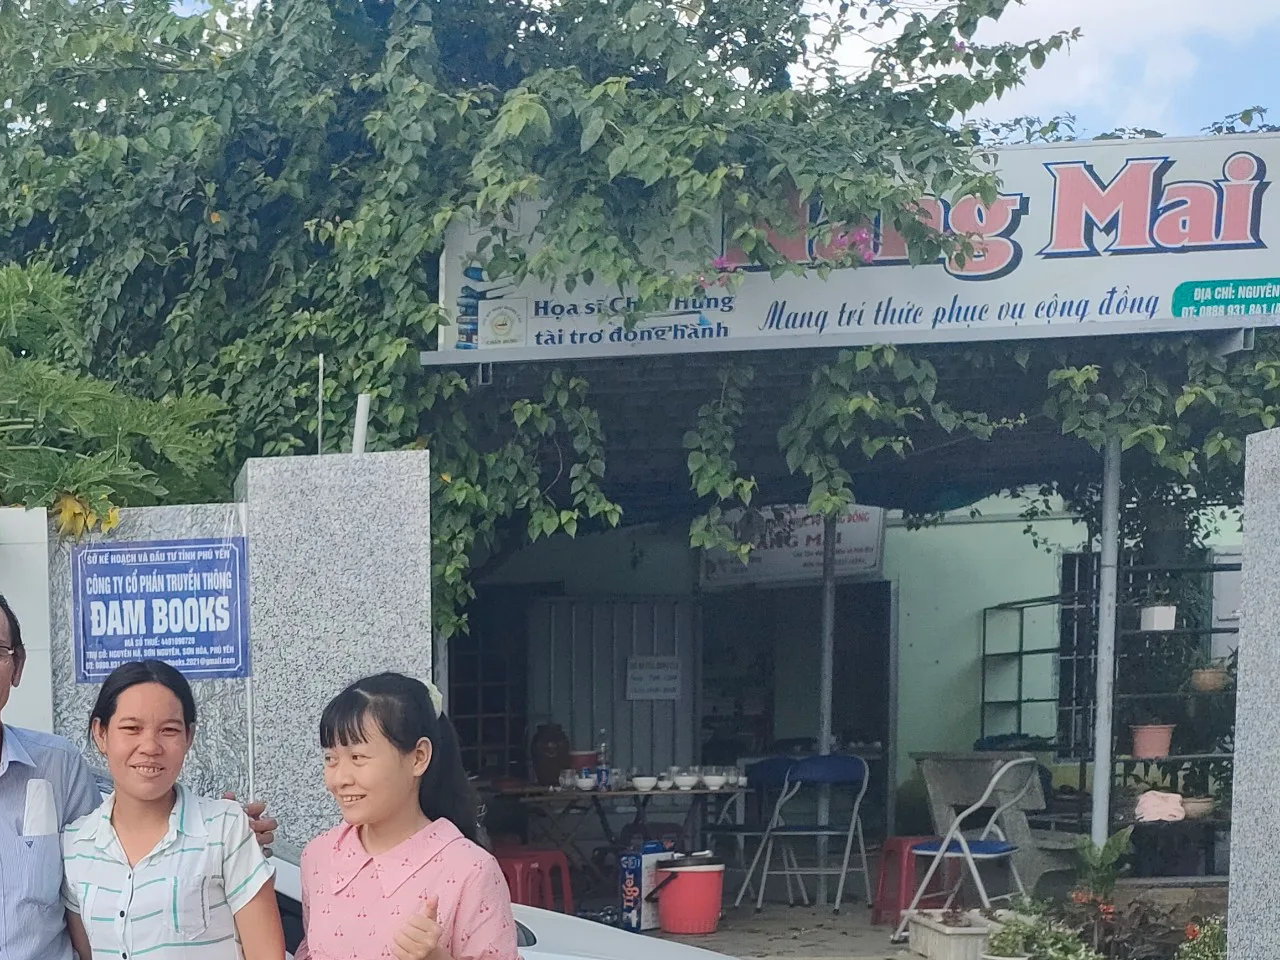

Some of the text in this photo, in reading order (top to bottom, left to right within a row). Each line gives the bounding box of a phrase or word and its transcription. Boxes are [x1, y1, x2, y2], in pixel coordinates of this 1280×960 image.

[1035, 151, 1271, 259] Mai
[1194, 287, 1212, 303] ĐỊA
[1214, 282, 1235, 299] CHỈ:
[534, 300, 579, 320] Họa
[758, 285, 1160, 334] Mang trí thức phục vụ cộng đồng
[535, 329, 563, 345] tài
[673, 322, 729, 340] hành
[111, 553, 137, 565] HOẠCH
[197, 548, 213, 560] PHÚ
[86, 568, 232, 595] CÔNG TY CỔ PHẦN TRUYỀN THÔNG
[90, 596, 230, 636] ĐAM BOOKS
[622, 870, 640, 928] Tiger
